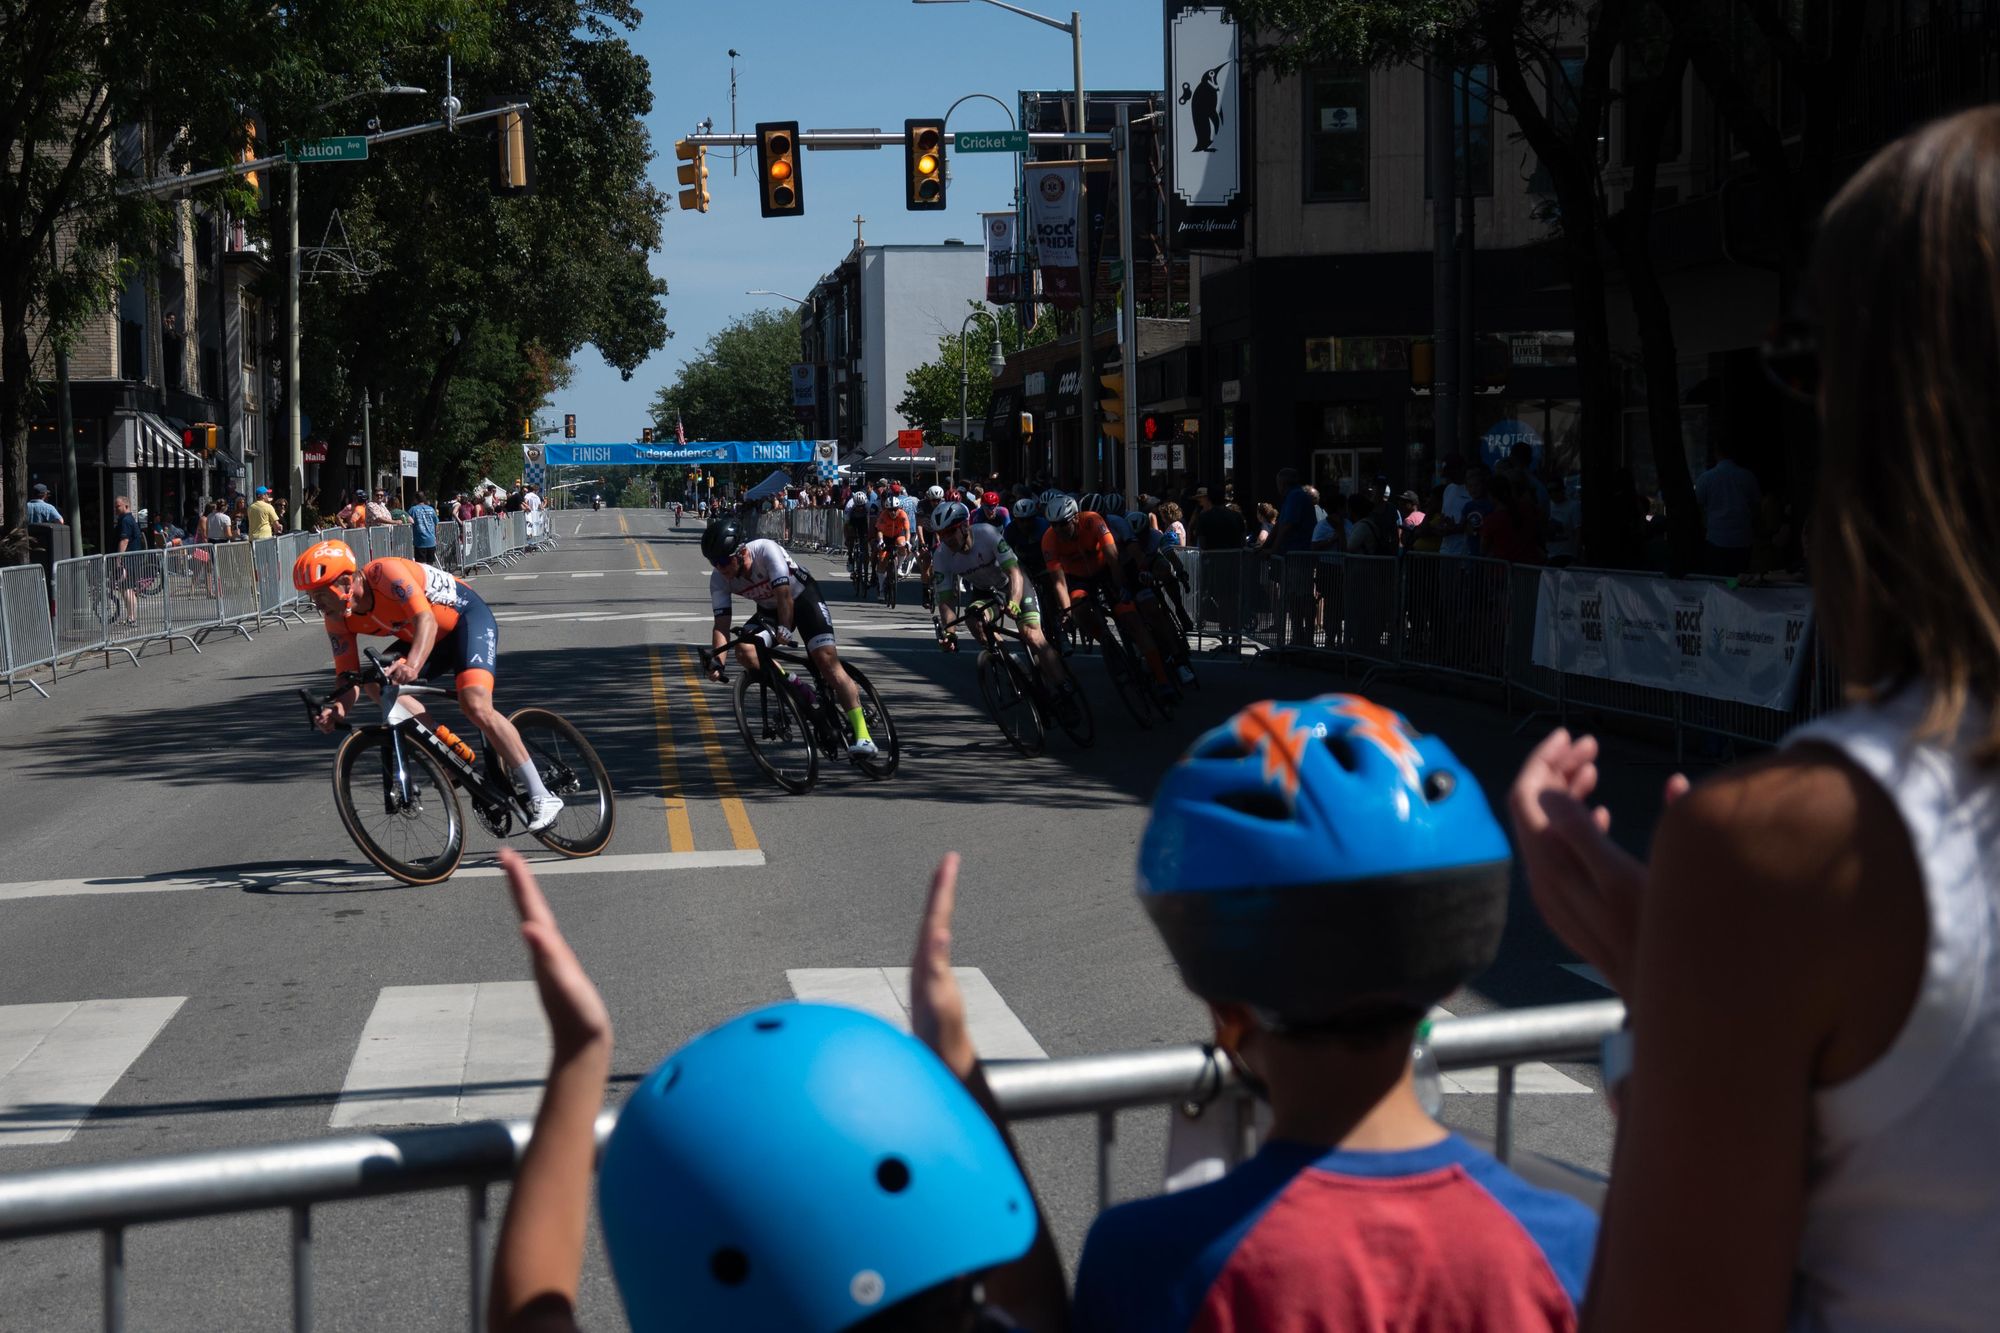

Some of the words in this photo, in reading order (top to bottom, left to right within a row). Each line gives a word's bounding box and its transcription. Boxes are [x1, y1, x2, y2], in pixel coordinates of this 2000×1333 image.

[961, 136, 1006, 149] Cricket
[298, 143, 342, 158] tation
[1512, 338, 1542, 346] BLACK
[1515, 347, 1540, 355] LIVES
[1513, 356, 1542, 364] MATTER
[1488, 433, 1535, 446] PROTECT
[305, 453, 326, 461] Nails
[573, 447, 611, 462] FINISH
[636, 446, 713, 460] Independence
[752, 445, 790, 459] FINISH
[1581, 600, 1601, 619] ROCK
[1676, 610, 1702, 632] ROCK
[1682, 634, 1702, 656] RIDE
[414, 717, 484, 785] TREK
